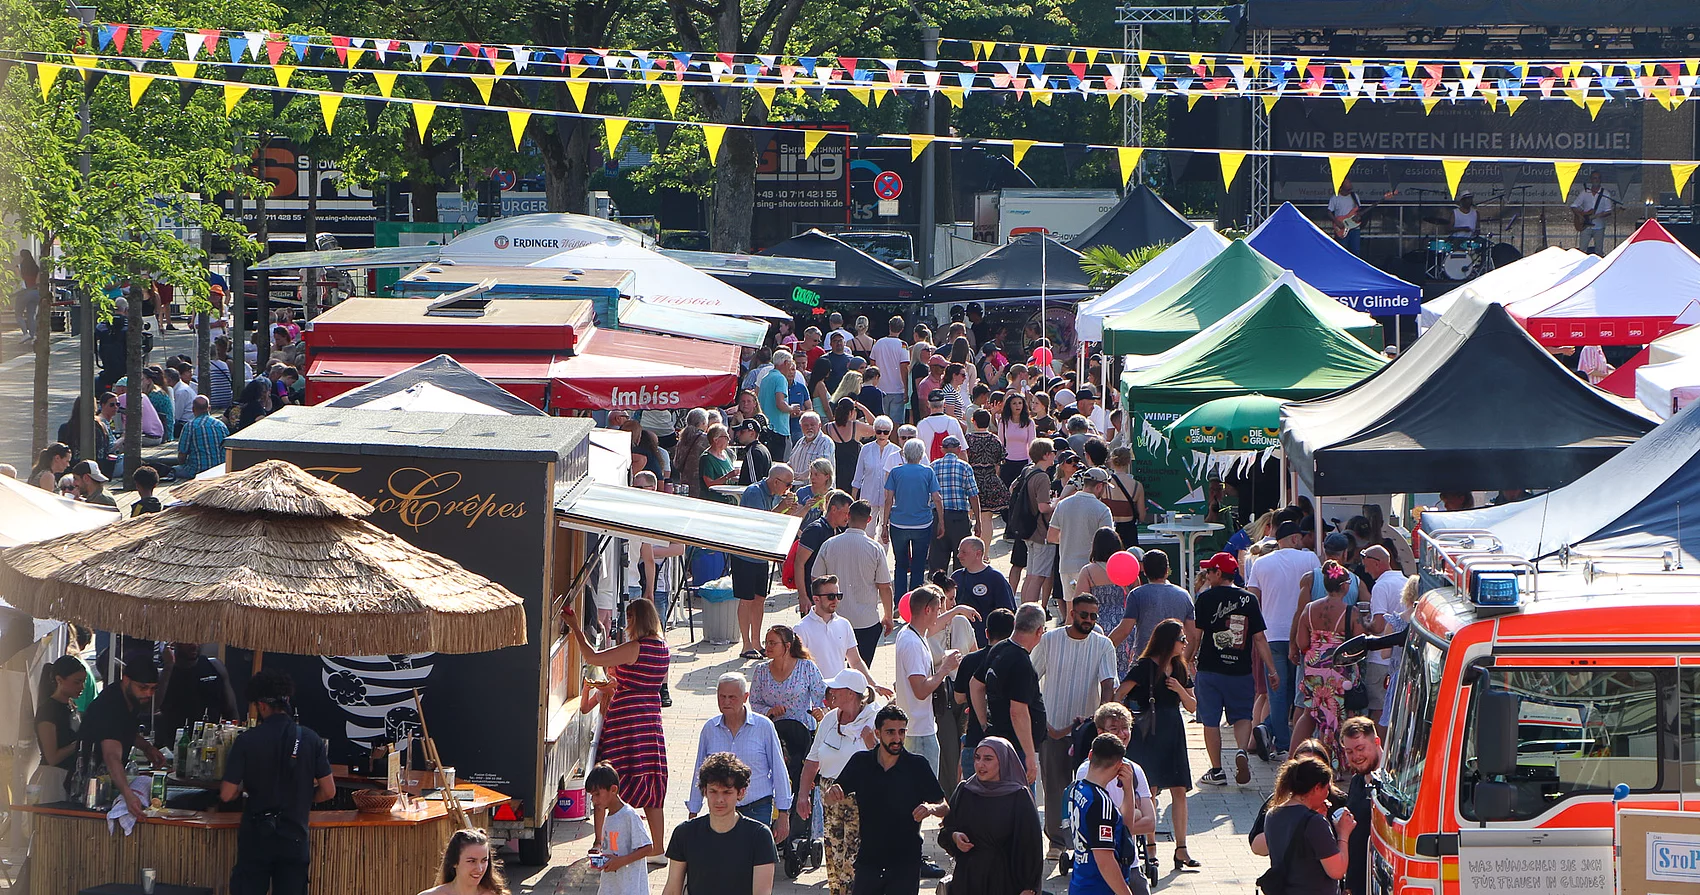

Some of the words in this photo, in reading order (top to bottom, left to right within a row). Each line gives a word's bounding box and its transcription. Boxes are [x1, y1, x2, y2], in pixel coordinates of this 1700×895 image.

[1286, 132, 1326, 148] WIR
[1333, 132, 1445, 149] BEWERTEN
[1454, 132, 1502, 149] IHRE
[1510, 132, 1631, 150] IMMOBILIE!
[1320, 164, 1374, 175] Konfrei
[461, 200, 548, 212] HAURGER
[514, 238, 559, 249] ERDINGER
[652, 294, 722, 306] Weißbier
[1362, 295, 1409, 308] Glinde
[612, 385, 680, 406] Imbiss
[1144, 412, 1182, 421] WIMPE
[1190, 428, 1200, 436] DIE
[1191, 434, 1217, 444] GRÜNEN
[388, 467, 528, 534] Crêpes
[1468, 860, 1493, 872] WAS
[1496, 858, 1556, 872] WÜNSCHEN
[1560, 859, 1577, 872] SIE
[1581, 859, 1602, 872] SICH
[1471, 874, 1496, 890] FÜR
[1496, 876, 1541, 890] FRAUEN
[1545, 876, 1556, 888] IN
[1560, 875, 1606, 890] GLINDE?
